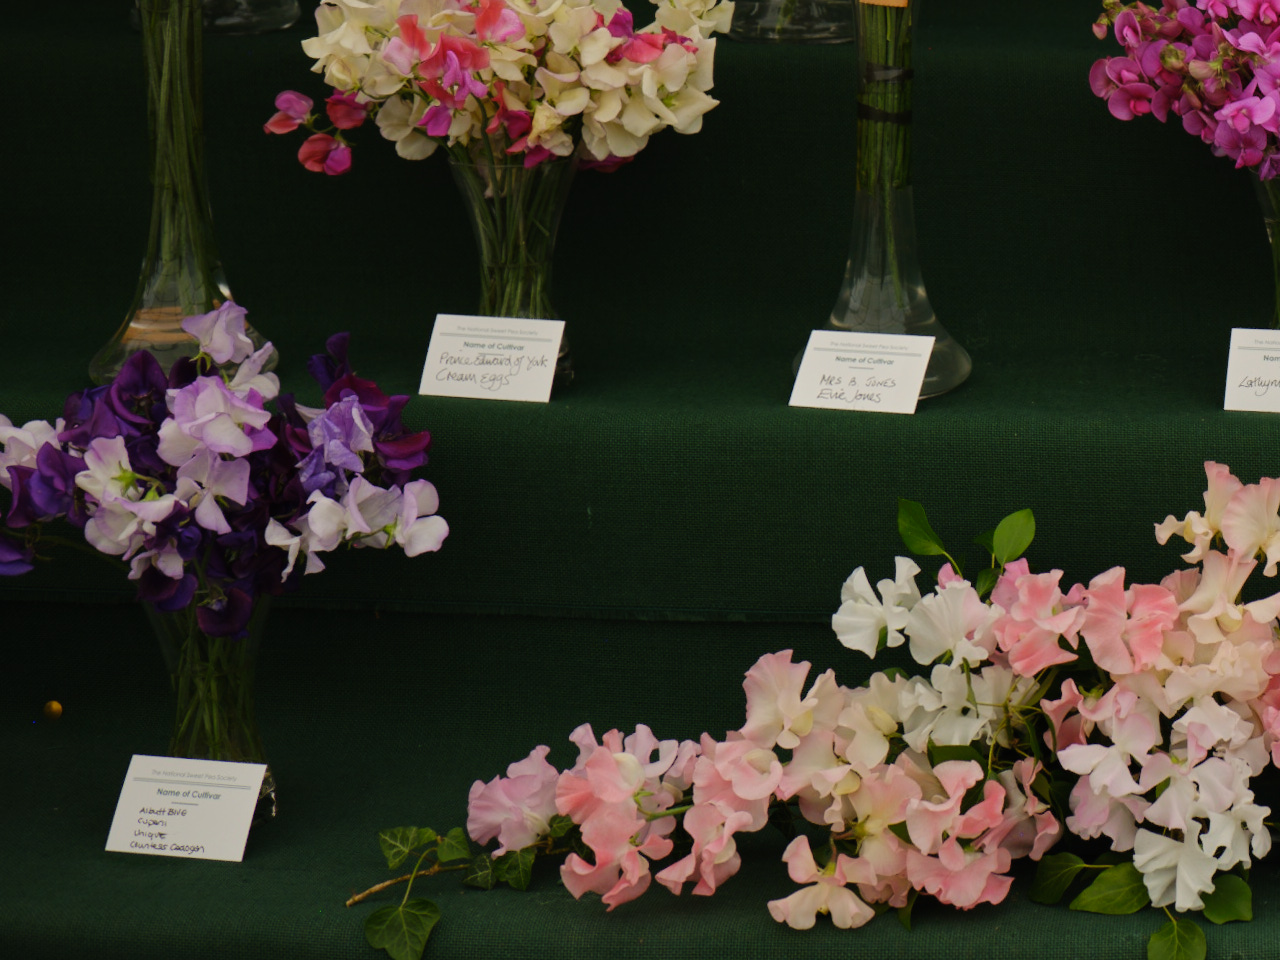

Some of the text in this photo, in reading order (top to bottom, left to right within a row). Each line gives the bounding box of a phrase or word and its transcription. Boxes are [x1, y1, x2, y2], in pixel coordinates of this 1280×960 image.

[464, 341, 485, 349] Name
[474, 354, 512, 366] Edward
[510, 356, 525, 376] of
[527, 355, 548, 371] York
[436, 368, 510, 392] Cream Eggs
[848, 377, 857, 386] B
[817, 388, 881, 403] Evie Jones
[157, 788, 221, 800] Name of Cultivar
